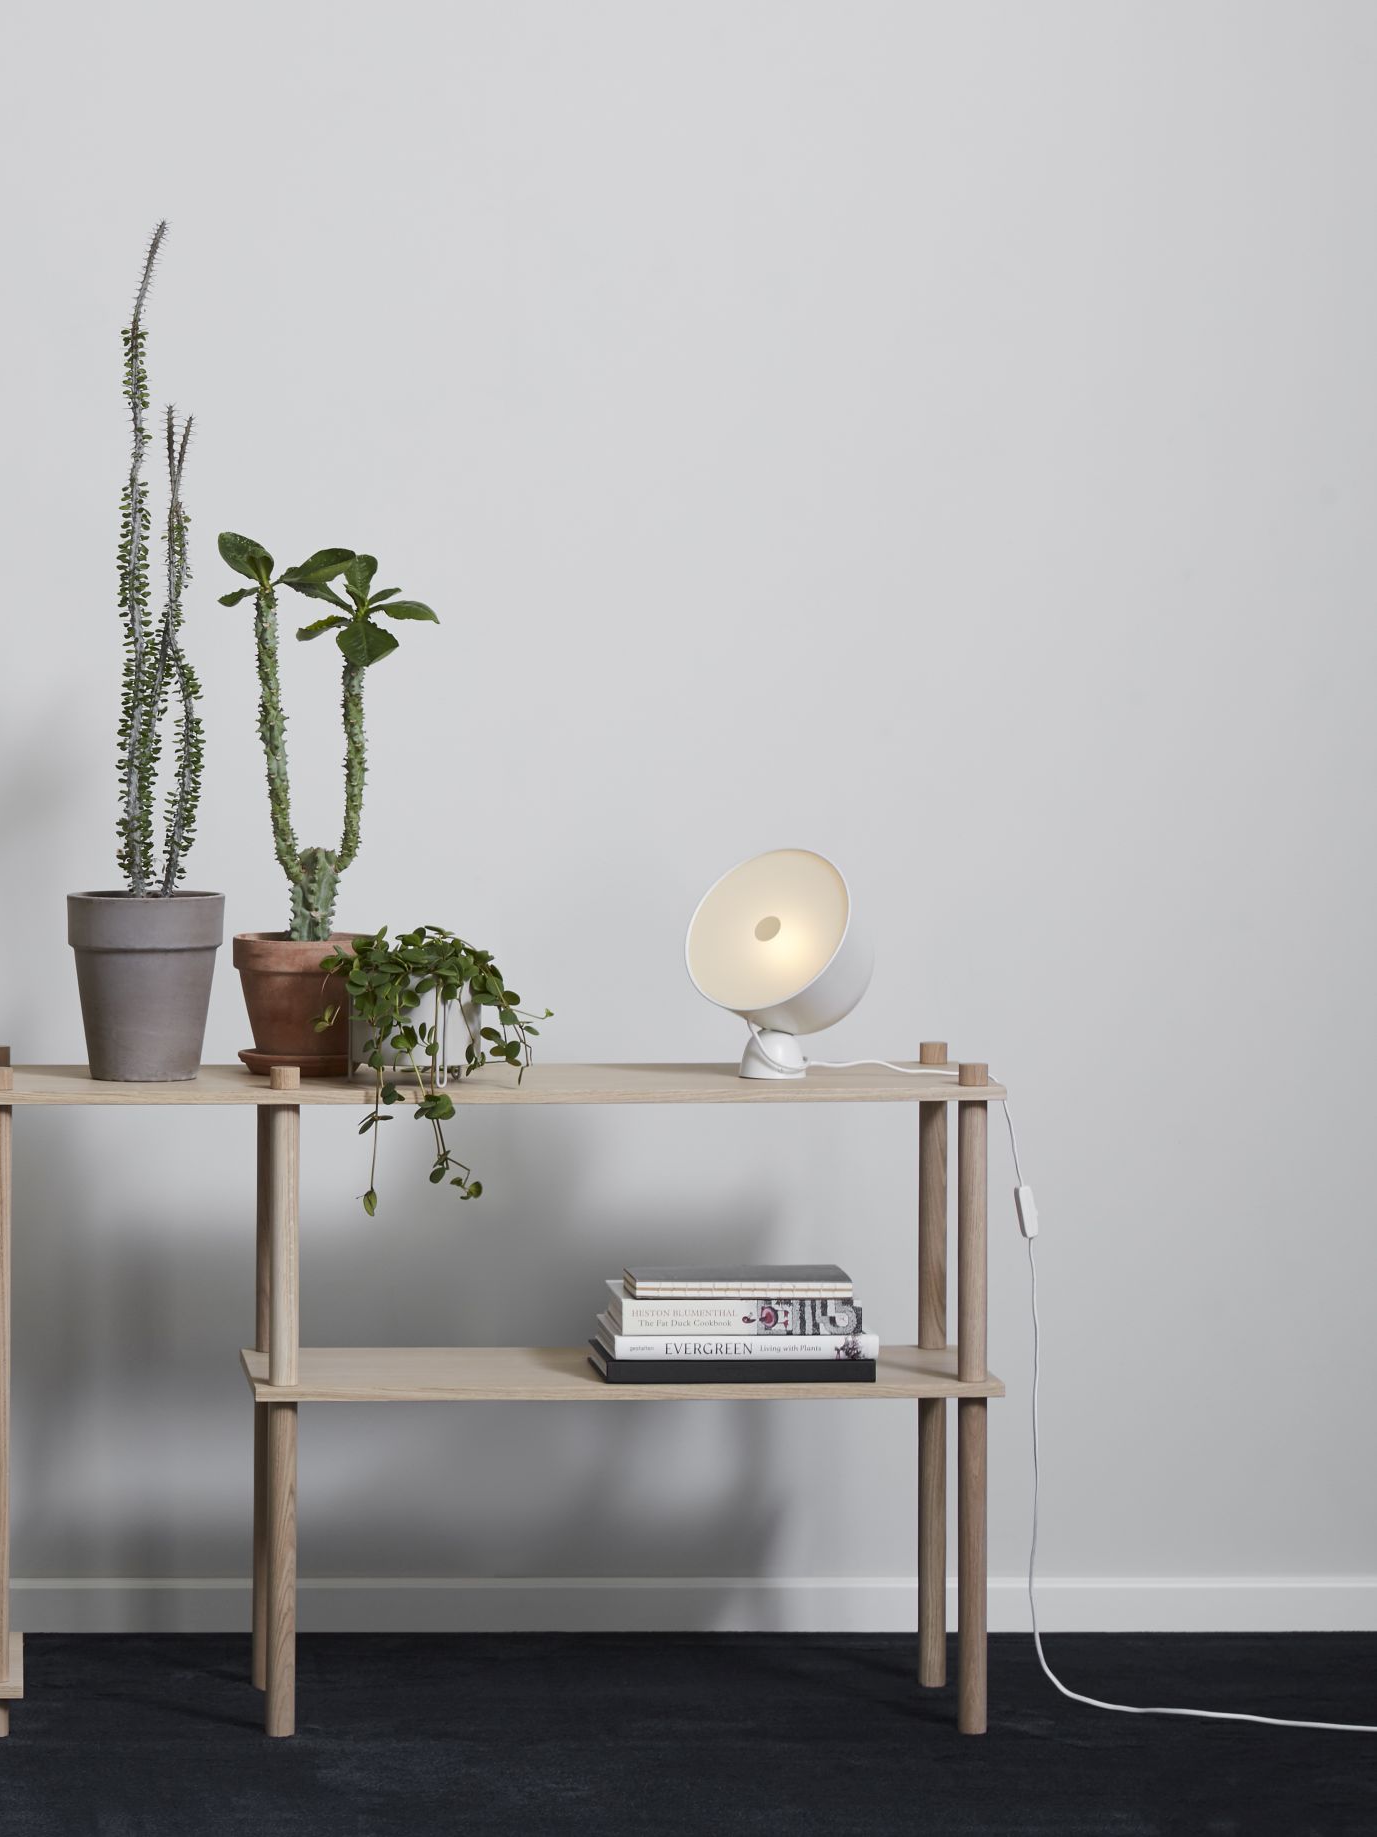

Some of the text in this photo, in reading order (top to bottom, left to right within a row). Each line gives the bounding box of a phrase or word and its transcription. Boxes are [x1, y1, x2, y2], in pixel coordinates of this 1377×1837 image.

[632, 1309, 738, 1317] HESTON BLUMENTHAL
[639, 1319, 732, 1327] The Fat Duck Cookbook
[665, 1342, 753, 1355] EVERGREEN
[759, 1344, 781, 1353] Living
[783, 1344, 799, 1352] with
